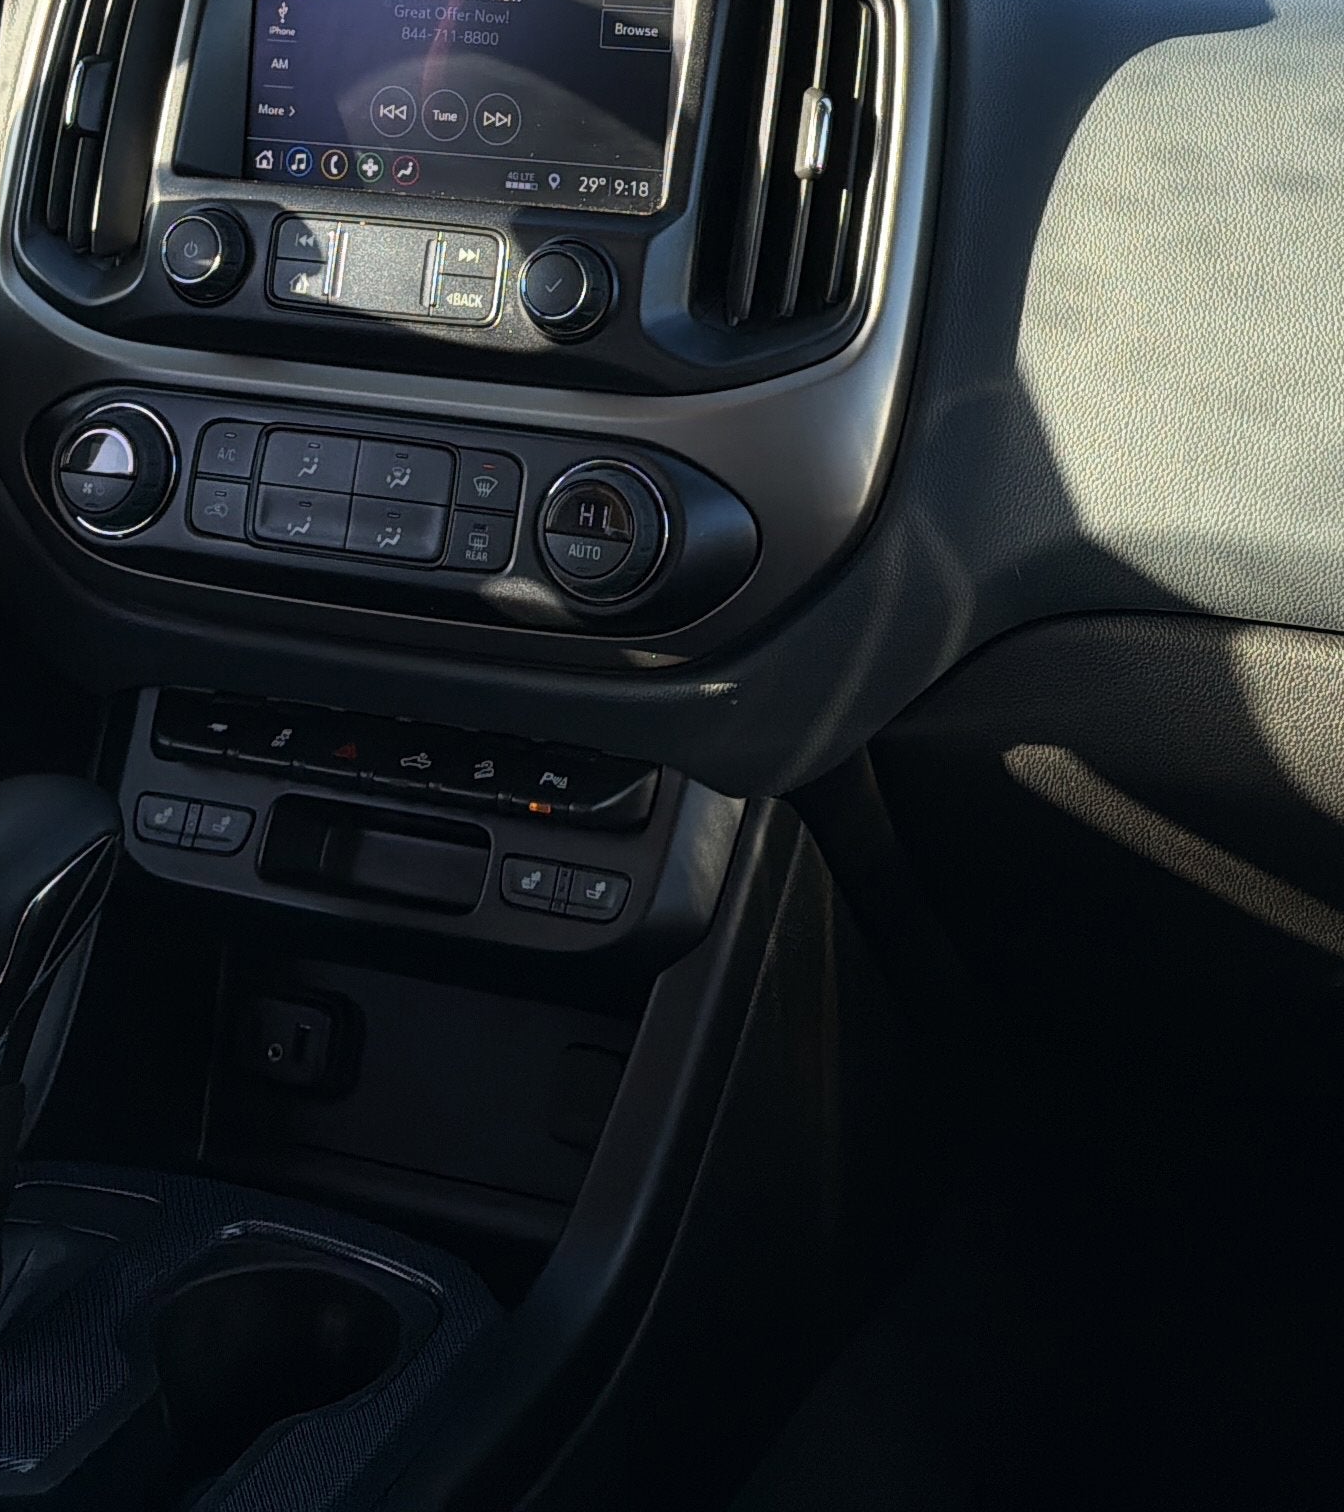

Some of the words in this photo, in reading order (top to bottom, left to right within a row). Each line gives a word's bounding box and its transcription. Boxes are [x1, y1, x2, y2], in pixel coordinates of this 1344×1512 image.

[394, 4, 431, 20] Great
[435, 6, 472, 22] Offer
[474, 9, 510, 24] Now!
[268, 24, 296, 37] iPhone
[401, 26, 500, 47] 844-711-8800
[614, 23, 659, 38] Browse
[270, 57, 290, 70] AM
[257, 103, 285, 116] More
[432, 109, 458, 123] Tune
[506, 172, 519, 181] 4G
[519, 172, 536, 182] LTE
[578, 176, 607, 193] 29°
[613, 179, 650, 198] 9:18
[452, 292, 484, 309] BACK
[216, 446, 237, 462] A/C
[465, 549, 489, 563] REAR
[567, 543, 602, 561] AUTO
